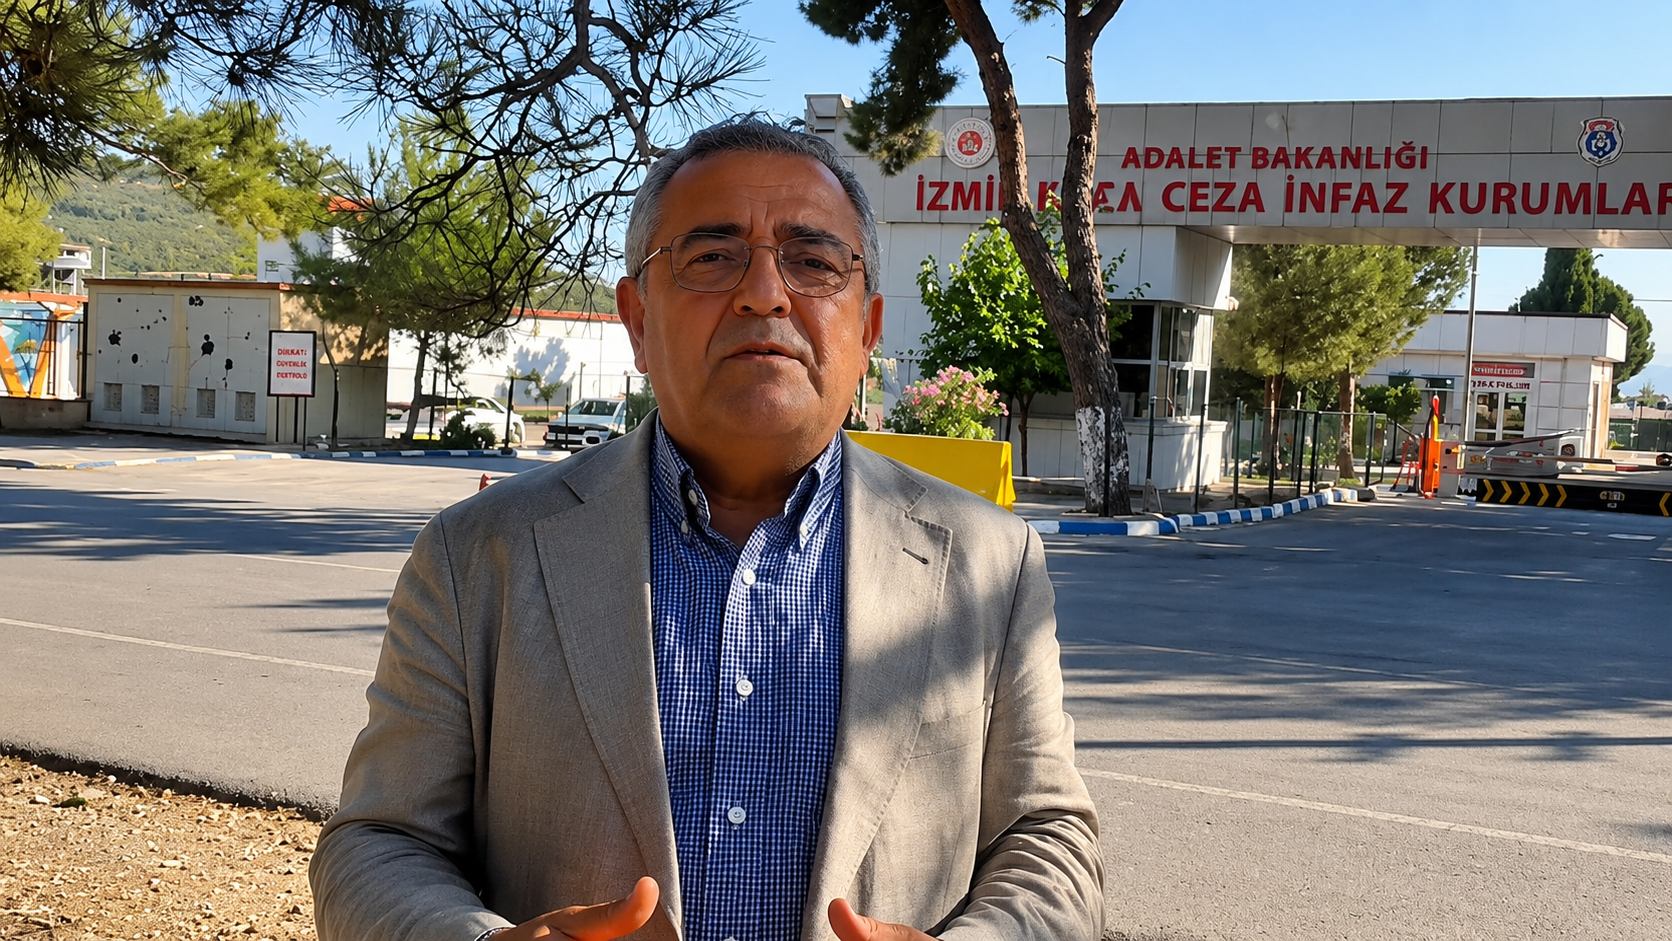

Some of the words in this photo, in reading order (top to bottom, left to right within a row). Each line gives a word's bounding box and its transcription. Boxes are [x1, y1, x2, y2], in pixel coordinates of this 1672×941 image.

[1122, 146, 1242, 170] ADALET
[1251, 141, 1428, 170] BAKANLIĞI
[916, 174, 1004, 212] İZMİ
[1161, 181, 1265, 213] CEZA
[1284, 174, 1409, 214] İNFAZ
